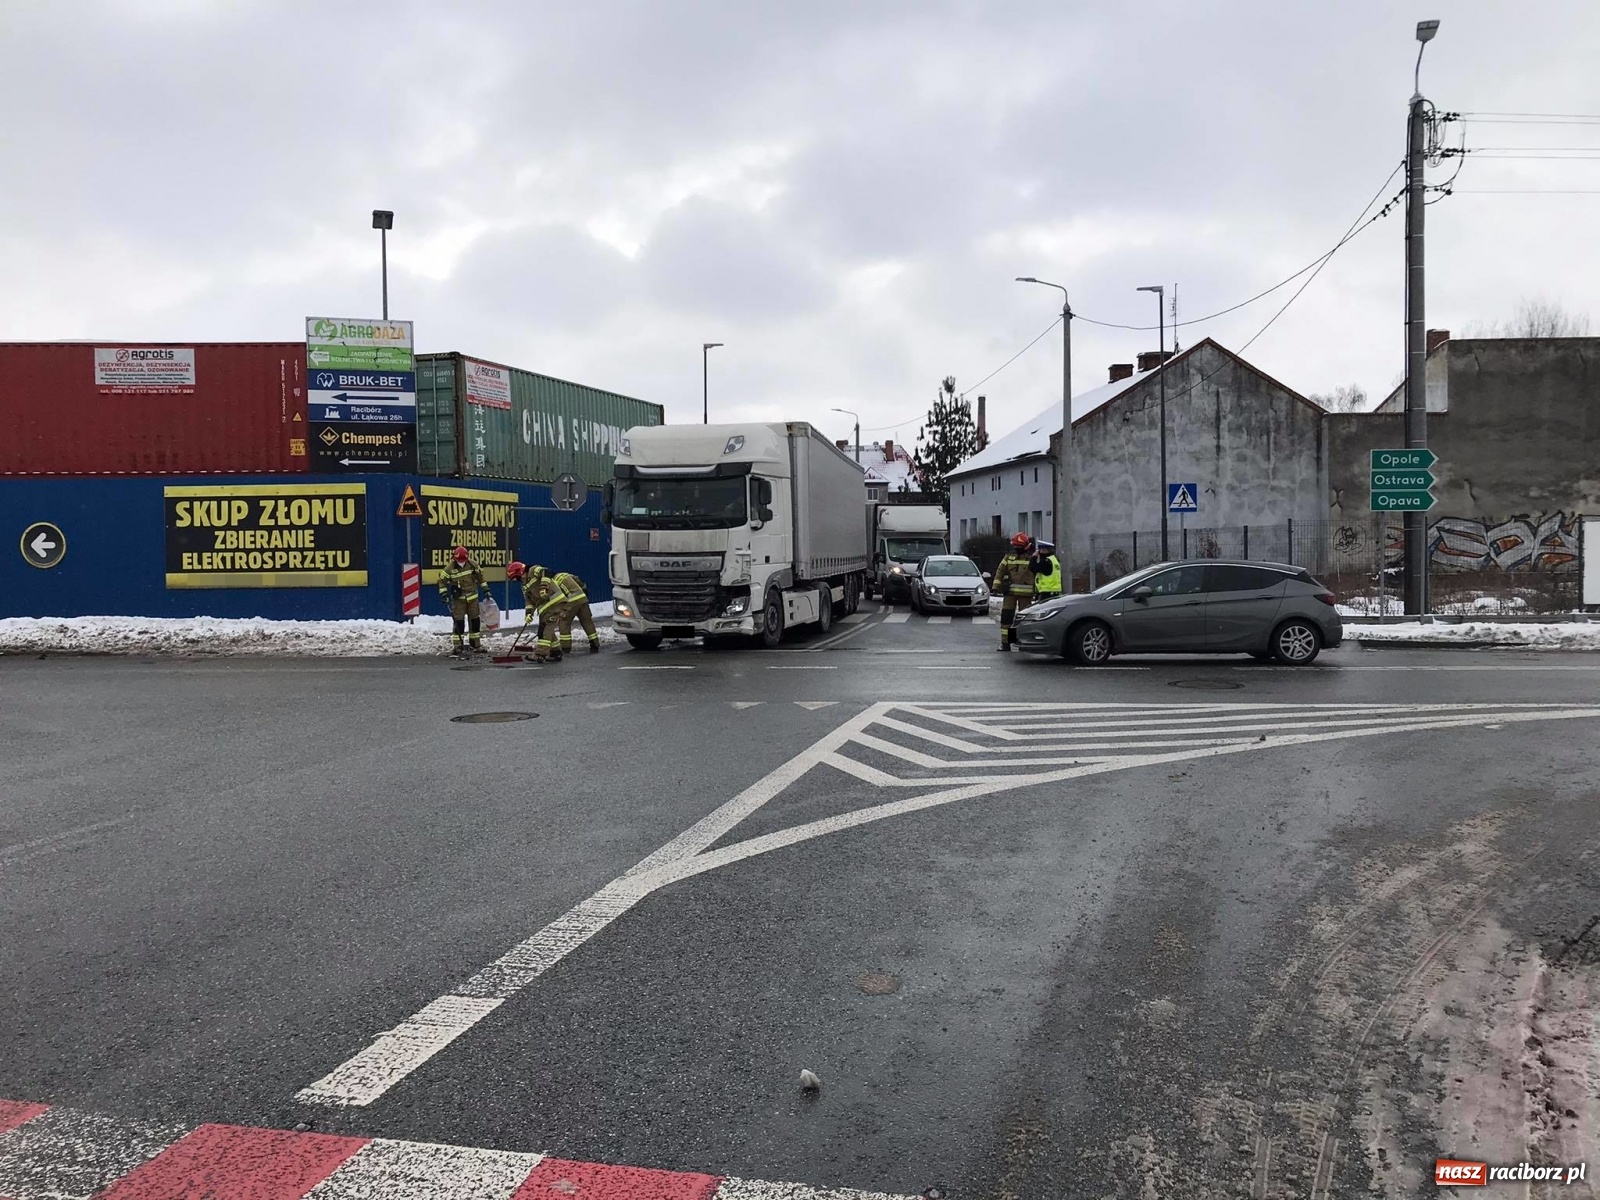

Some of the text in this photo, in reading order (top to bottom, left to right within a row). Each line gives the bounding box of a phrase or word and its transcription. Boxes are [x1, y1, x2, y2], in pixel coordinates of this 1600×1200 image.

[339, 375, 403, 386] BRUK-BET
[522, 408, 565, 450] CHINA
[341, 432, 402, 446] Chempest
[319, 450, 408, 458] www.chempest.pl
[1380, 453, 1420, 467] Opole
[1374, 474, 1425, 485] Ostrava
[1378, 495, 1420, 508] Opava
[175, 498, 355, 527] SKUP ZŁOMU
[428, 500, 515, 529] SKUP ZŁOMU
[214, 529, 315, 549] ZBIERANIE
[451, 529, 497, 547] ZBIERANIE
[182, 550, 350, 570] ELEKTROSPRZĘTU
[659, 560, 692, 568] DAF
